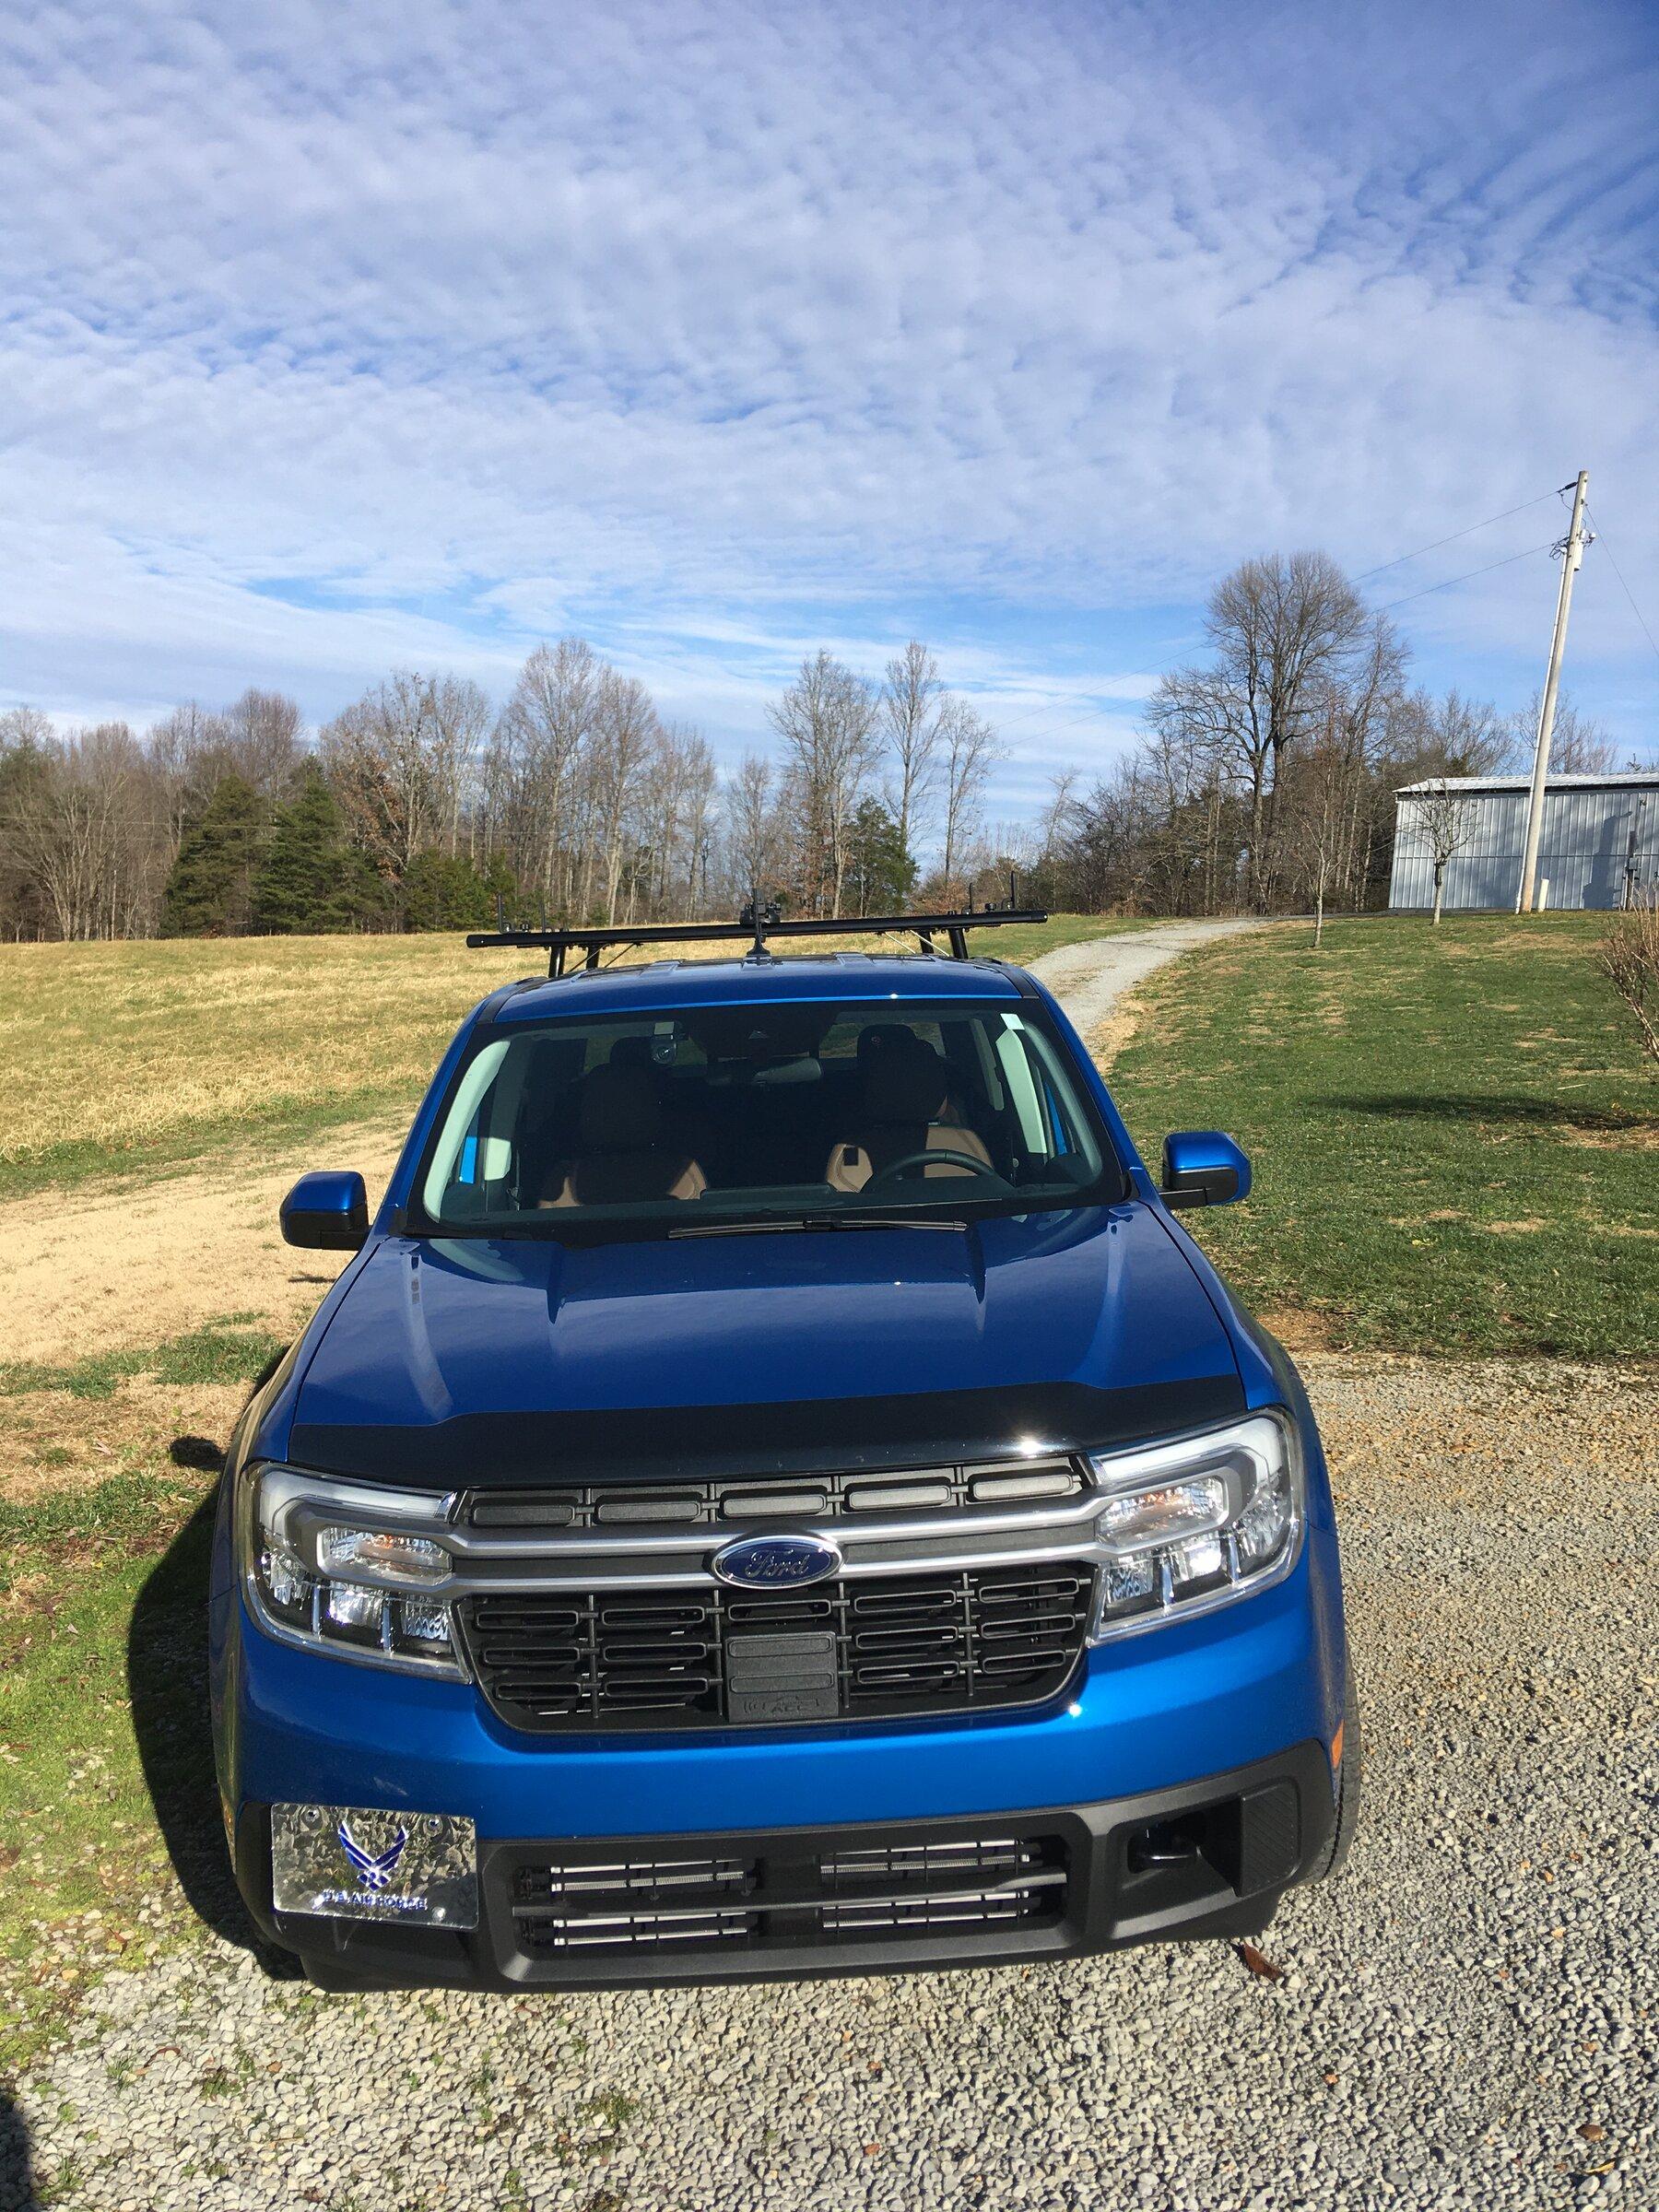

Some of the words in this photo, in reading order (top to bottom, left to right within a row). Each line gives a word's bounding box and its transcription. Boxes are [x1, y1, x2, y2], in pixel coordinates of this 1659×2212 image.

[745, 1549, 810, 1578] Ford
[351, 1890, 376, 1906] AIR
[376, 1893, 429, 1911] FORCE
